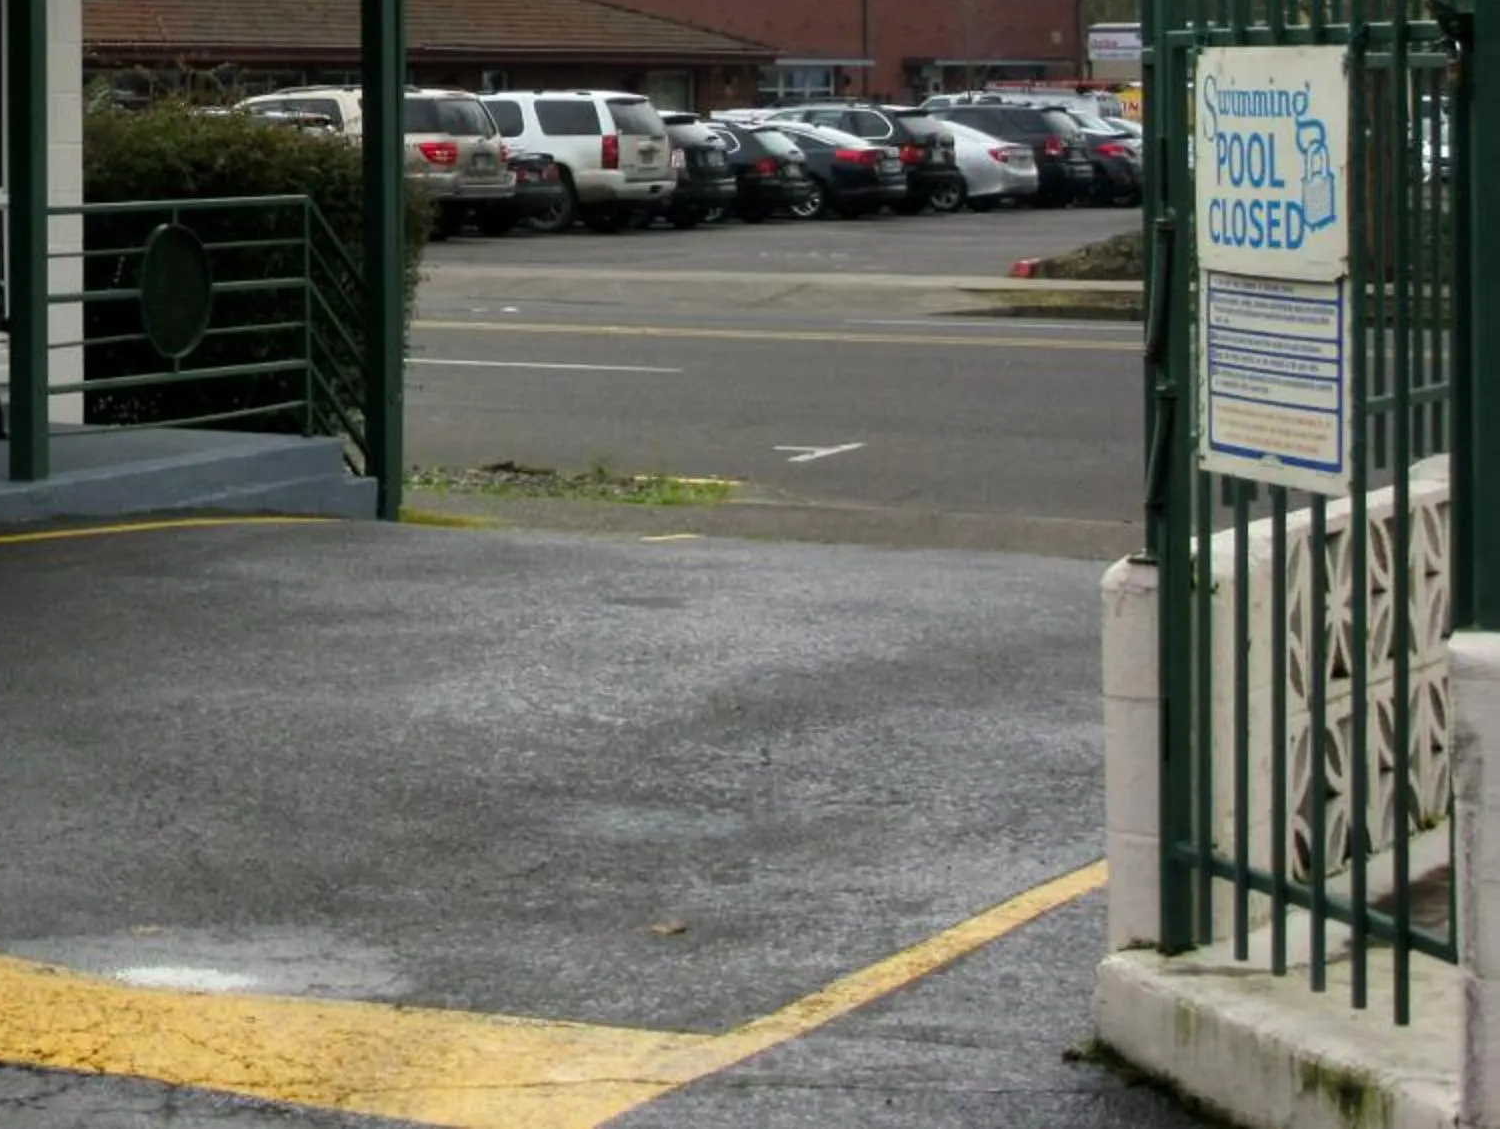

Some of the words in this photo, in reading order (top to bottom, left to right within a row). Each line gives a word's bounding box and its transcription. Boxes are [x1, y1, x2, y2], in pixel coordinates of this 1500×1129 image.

[1203, 74, 1310, 139] Swimming
[1216, 131, 1285, 189] POOL
[1209, 198, 1305, 250] CLOSED
